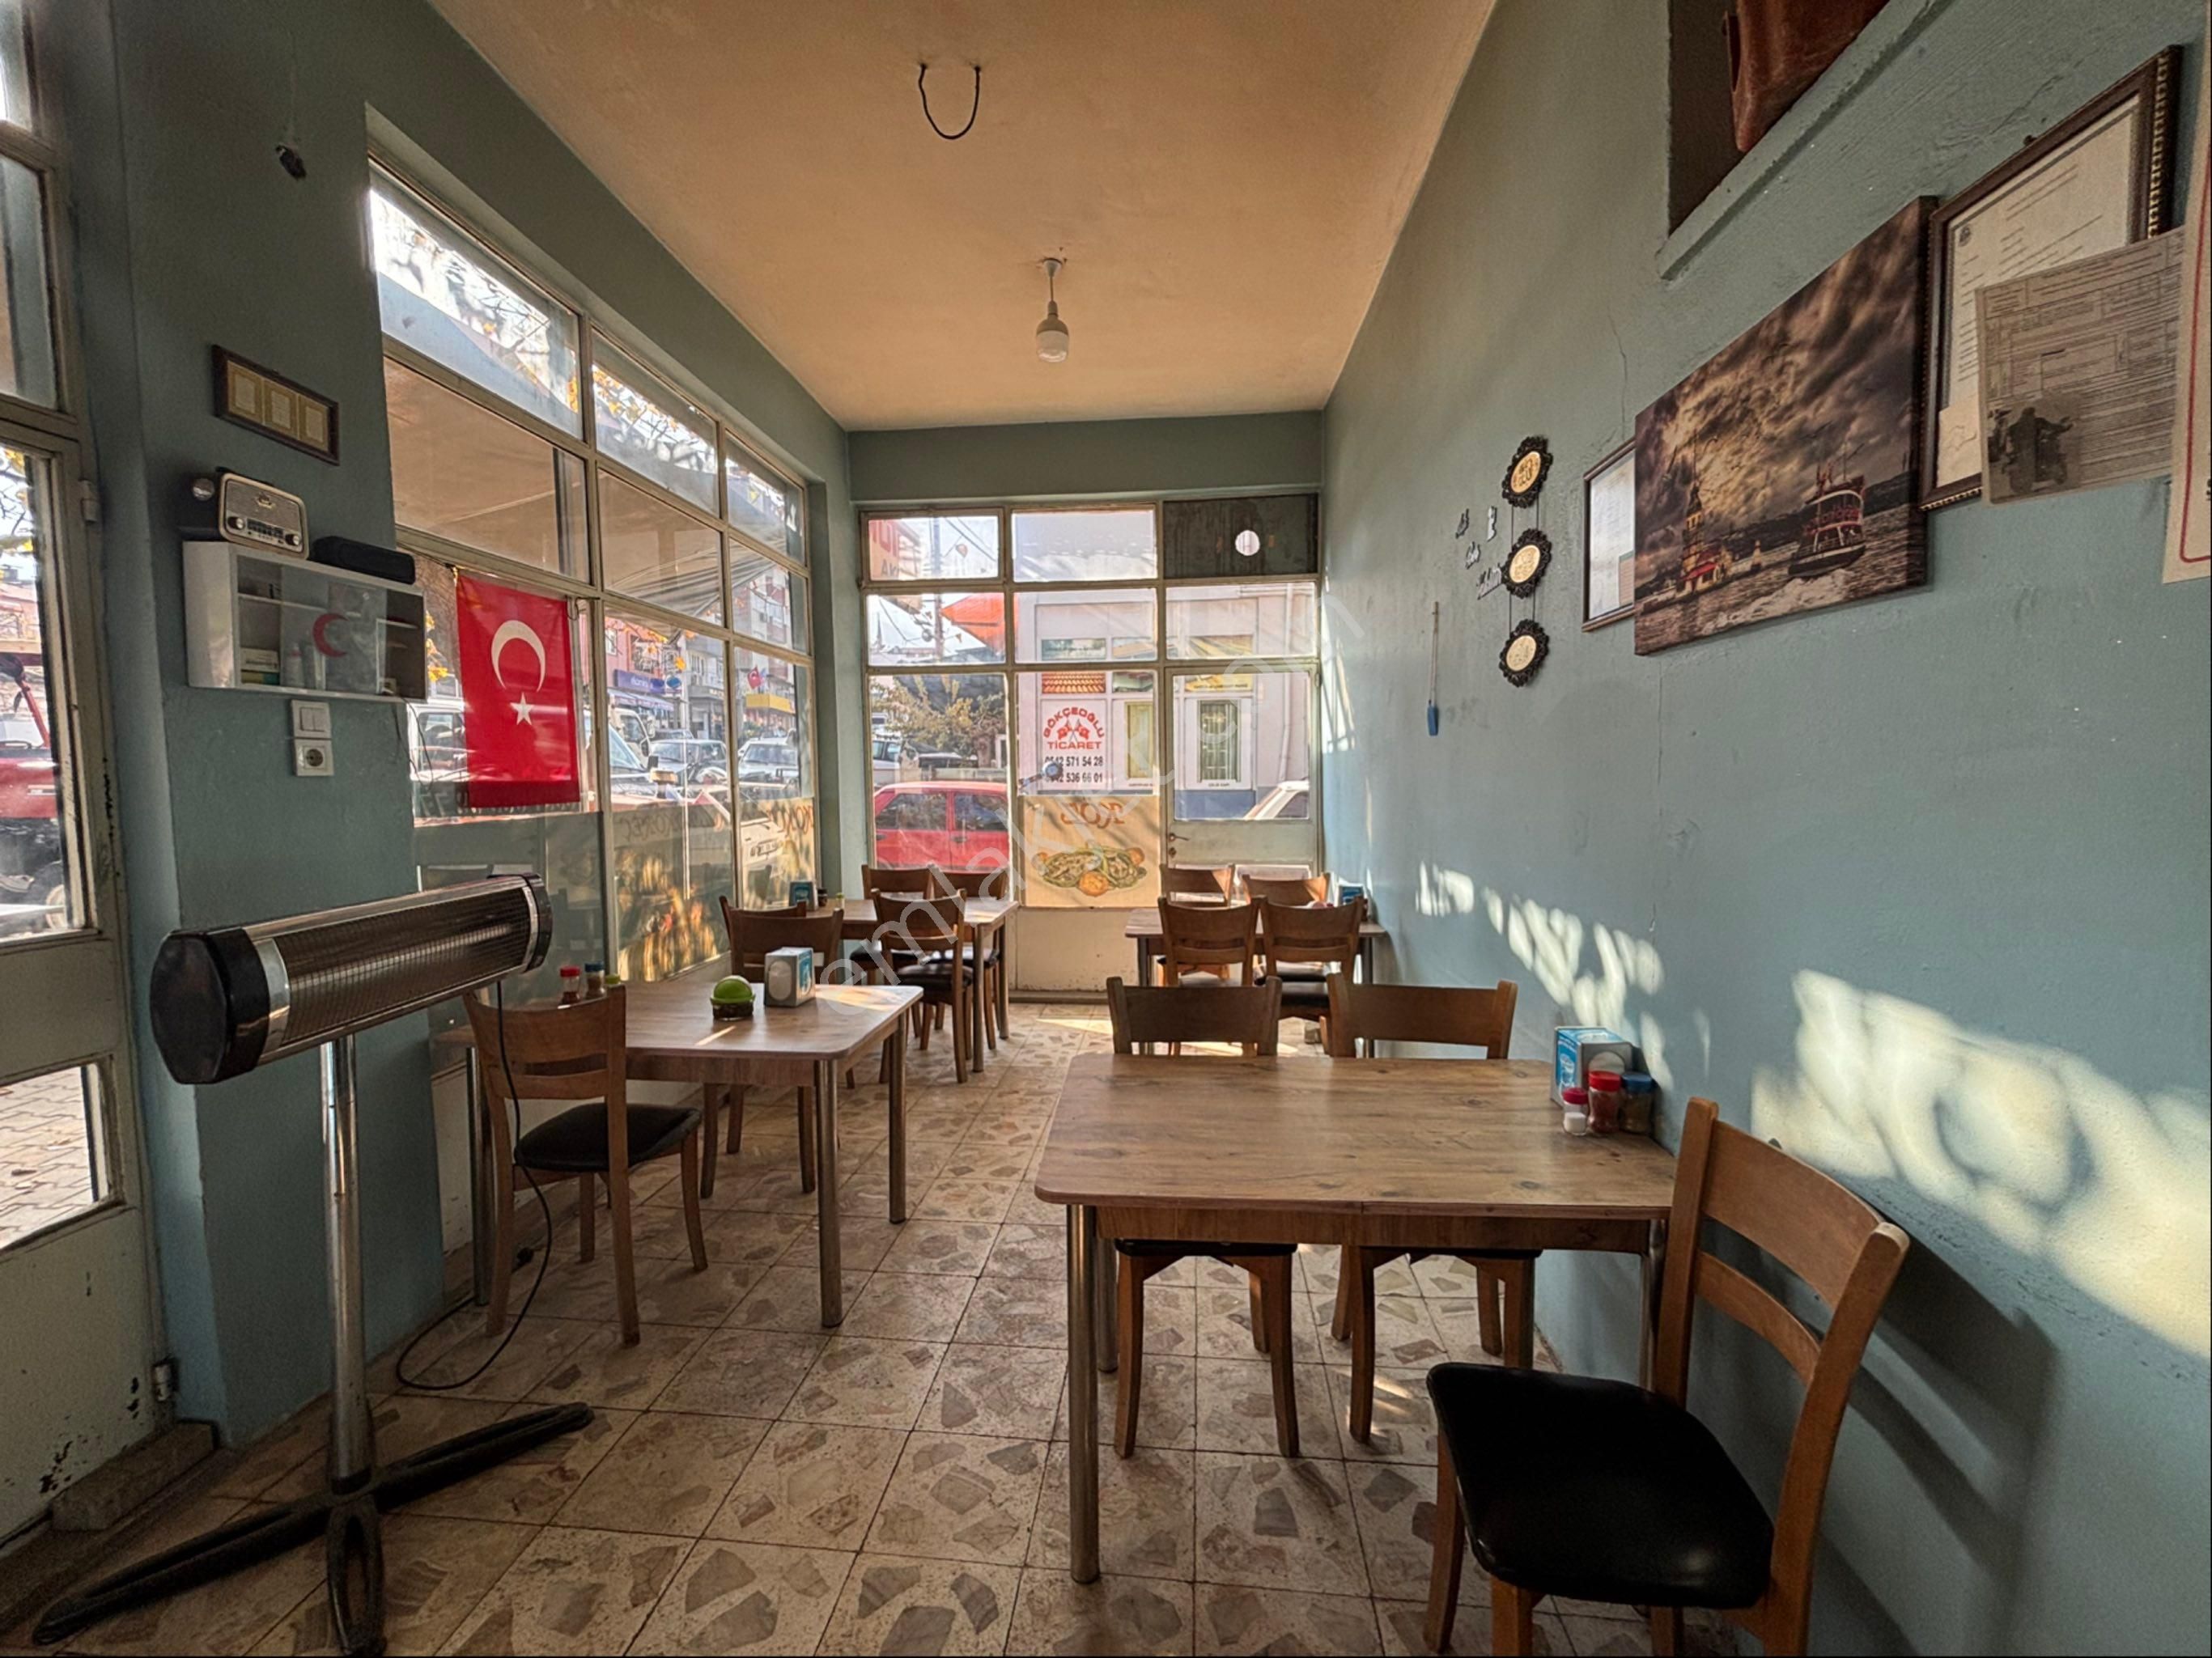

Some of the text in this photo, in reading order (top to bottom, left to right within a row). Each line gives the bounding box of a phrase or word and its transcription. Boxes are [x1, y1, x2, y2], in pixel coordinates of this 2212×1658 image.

[1047, 740, 1102, 749] TİCARET
[1066, 756, 1080, 766] 571
[1082, 756, 1092, 766] 54
[1093, 756, 1103, 766] 28
[1066, 773, 1080, 782] 536
[1082, 773, 1092, 782] 66
[1093, 773, 1103, 782] 01
